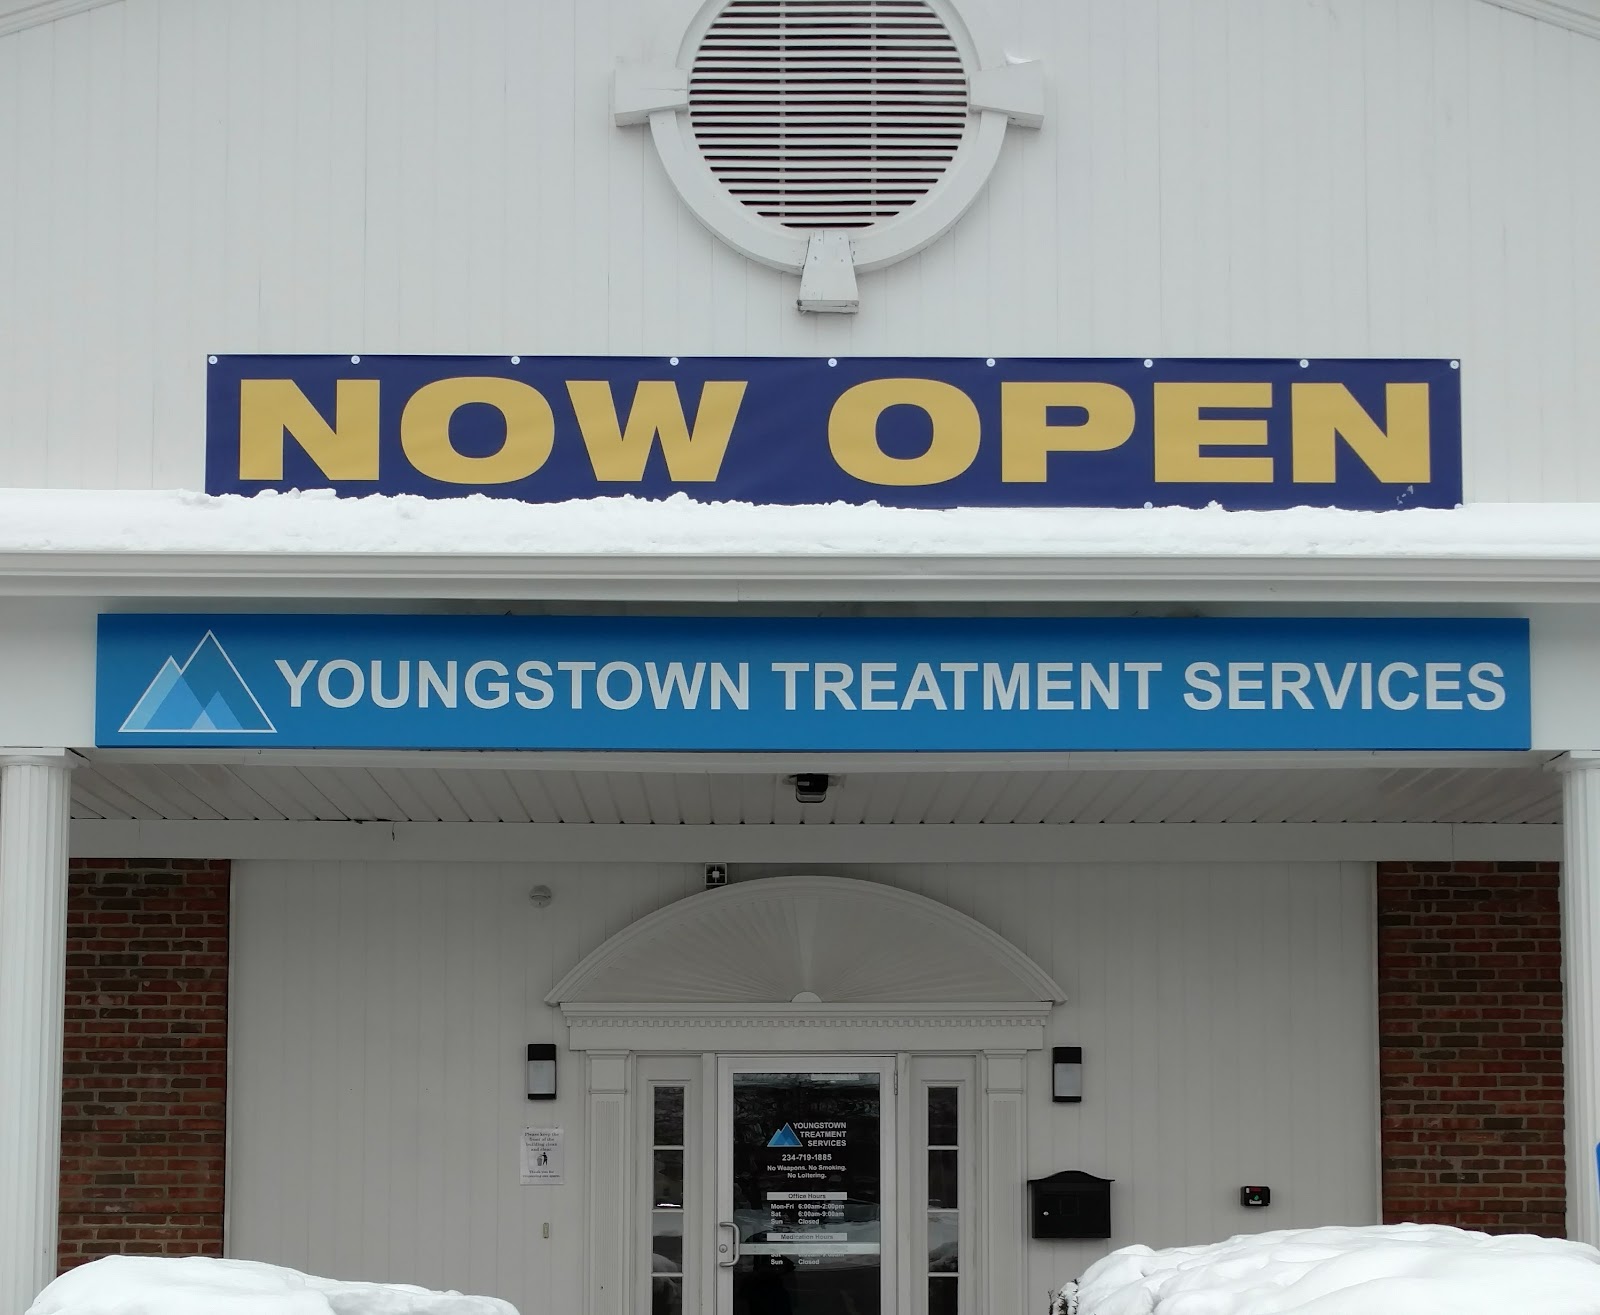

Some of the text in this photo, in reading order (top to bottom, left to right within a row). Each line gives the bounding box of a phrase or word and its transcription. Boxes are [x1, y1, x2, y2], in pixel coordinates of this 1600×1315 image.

[239, 376, 1431, 486] NOW OPEN
[274, 658, 1507, 713] YOUNGSTOWN TREATMENT SERVICES
[781, 1153, 833, 1161] 234-719-1885
